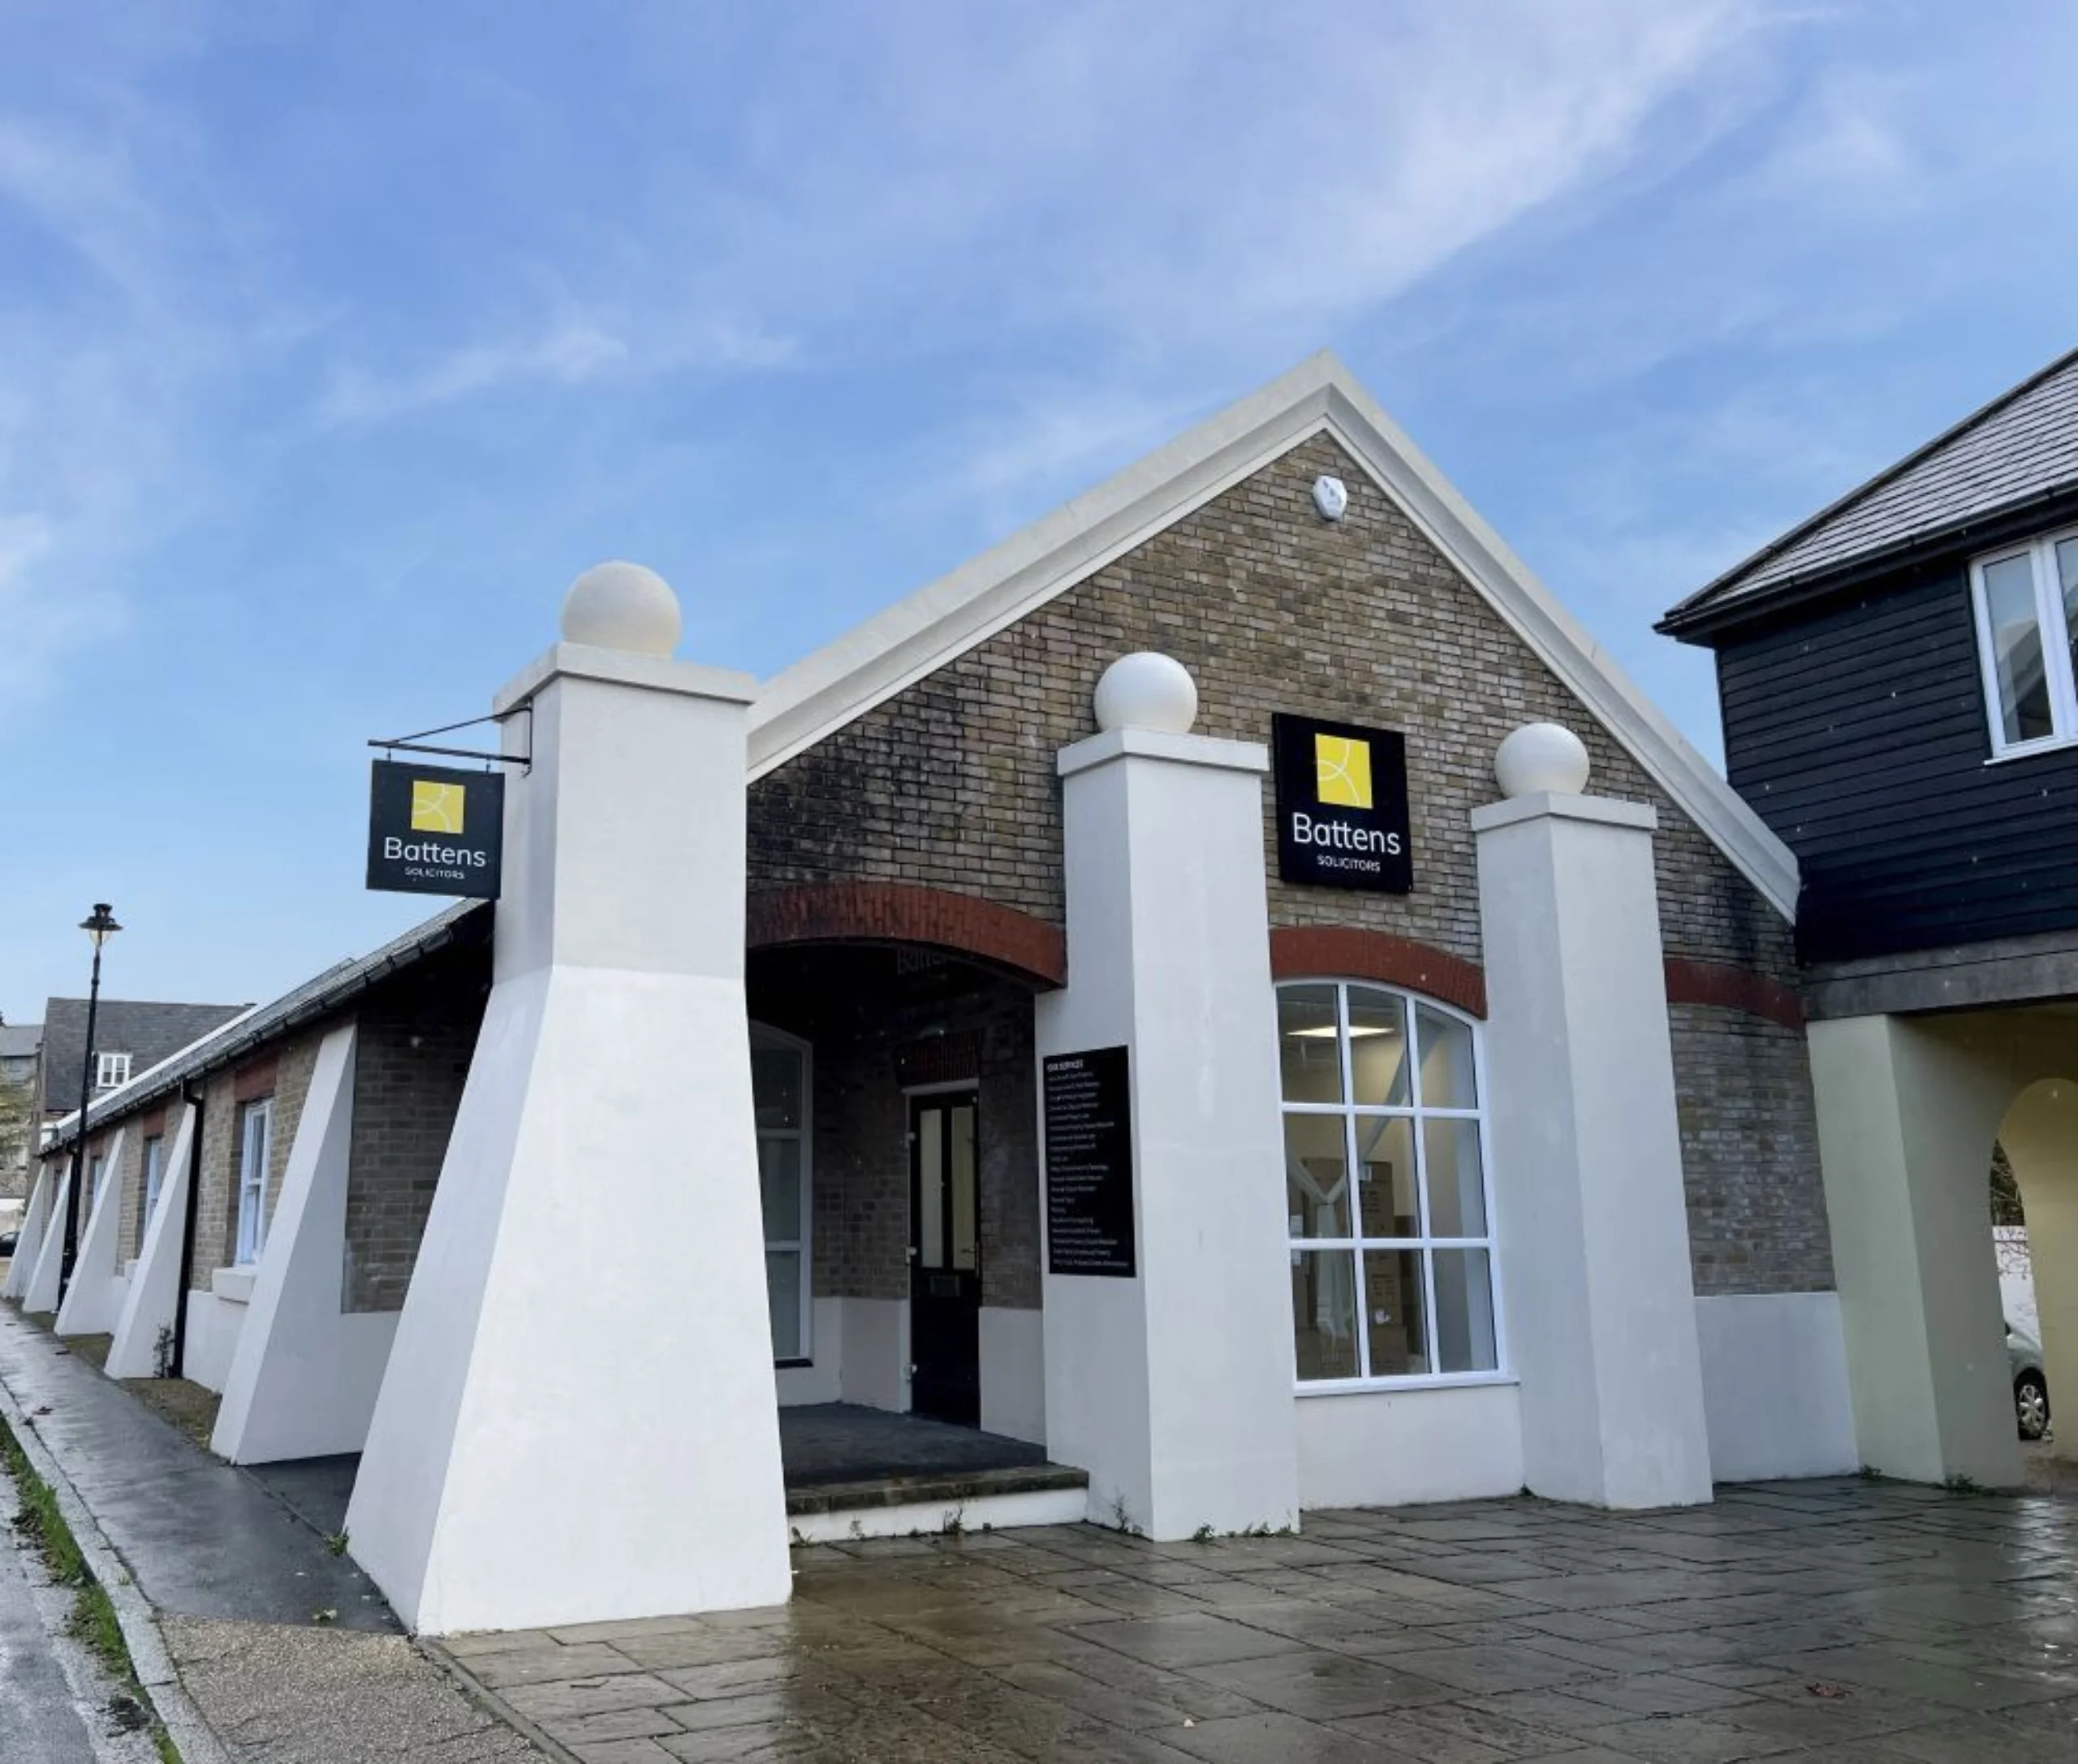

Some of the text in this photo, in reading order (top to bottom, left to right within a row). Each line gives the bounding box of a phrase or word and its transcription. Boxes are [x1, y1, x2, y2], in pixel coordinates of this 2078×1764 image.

[1293, 812, 1401, 855] Battens
[384, 836, 486, 867] Battens
[1317, 854, 1381, 873] SOLICITORS
[405, 866, 465, 880] SOLICITORS
